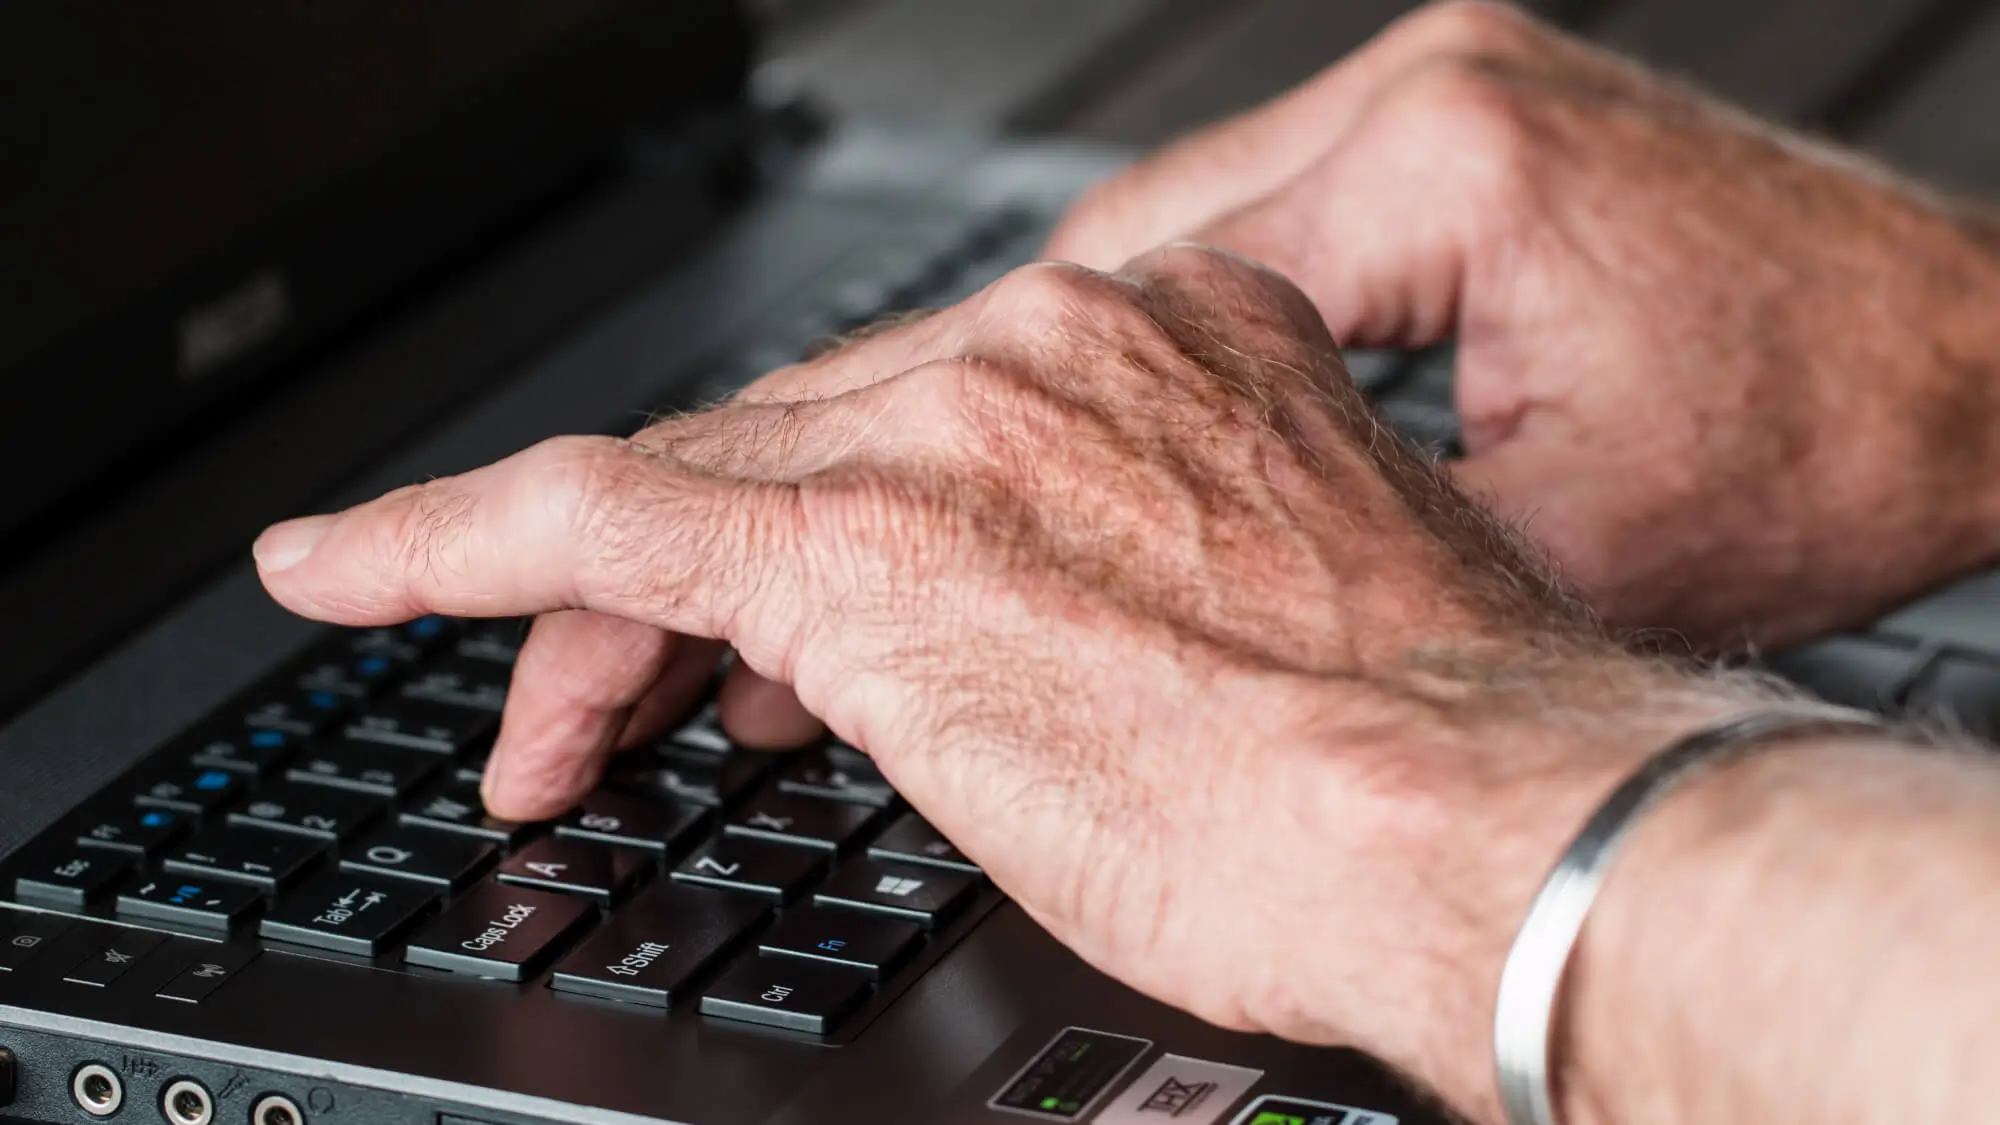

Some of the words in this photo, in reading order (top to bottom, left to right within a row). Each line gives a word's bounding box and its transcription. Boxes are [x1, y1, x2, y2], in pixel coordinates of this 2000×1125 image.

[303, 815, 336, 830] 2
[579, 812, 622, 832] S
[366, 847, 413, 865] Q
[54, 859, 90, 877] Esc
[244, 861, 272, 872] 1
[524, 861, 568, 878] A
[694, 855, 740, 876] Z
[312, 901, 354, 926] Tab
[460, 926, 509, 952] Caps
[489, 903, 537, 930] Lock
[817, 939, 849, 952] Fn
[620, 941, 670, 970] Shift
[760, 984, 795, 1003] Ctrl
